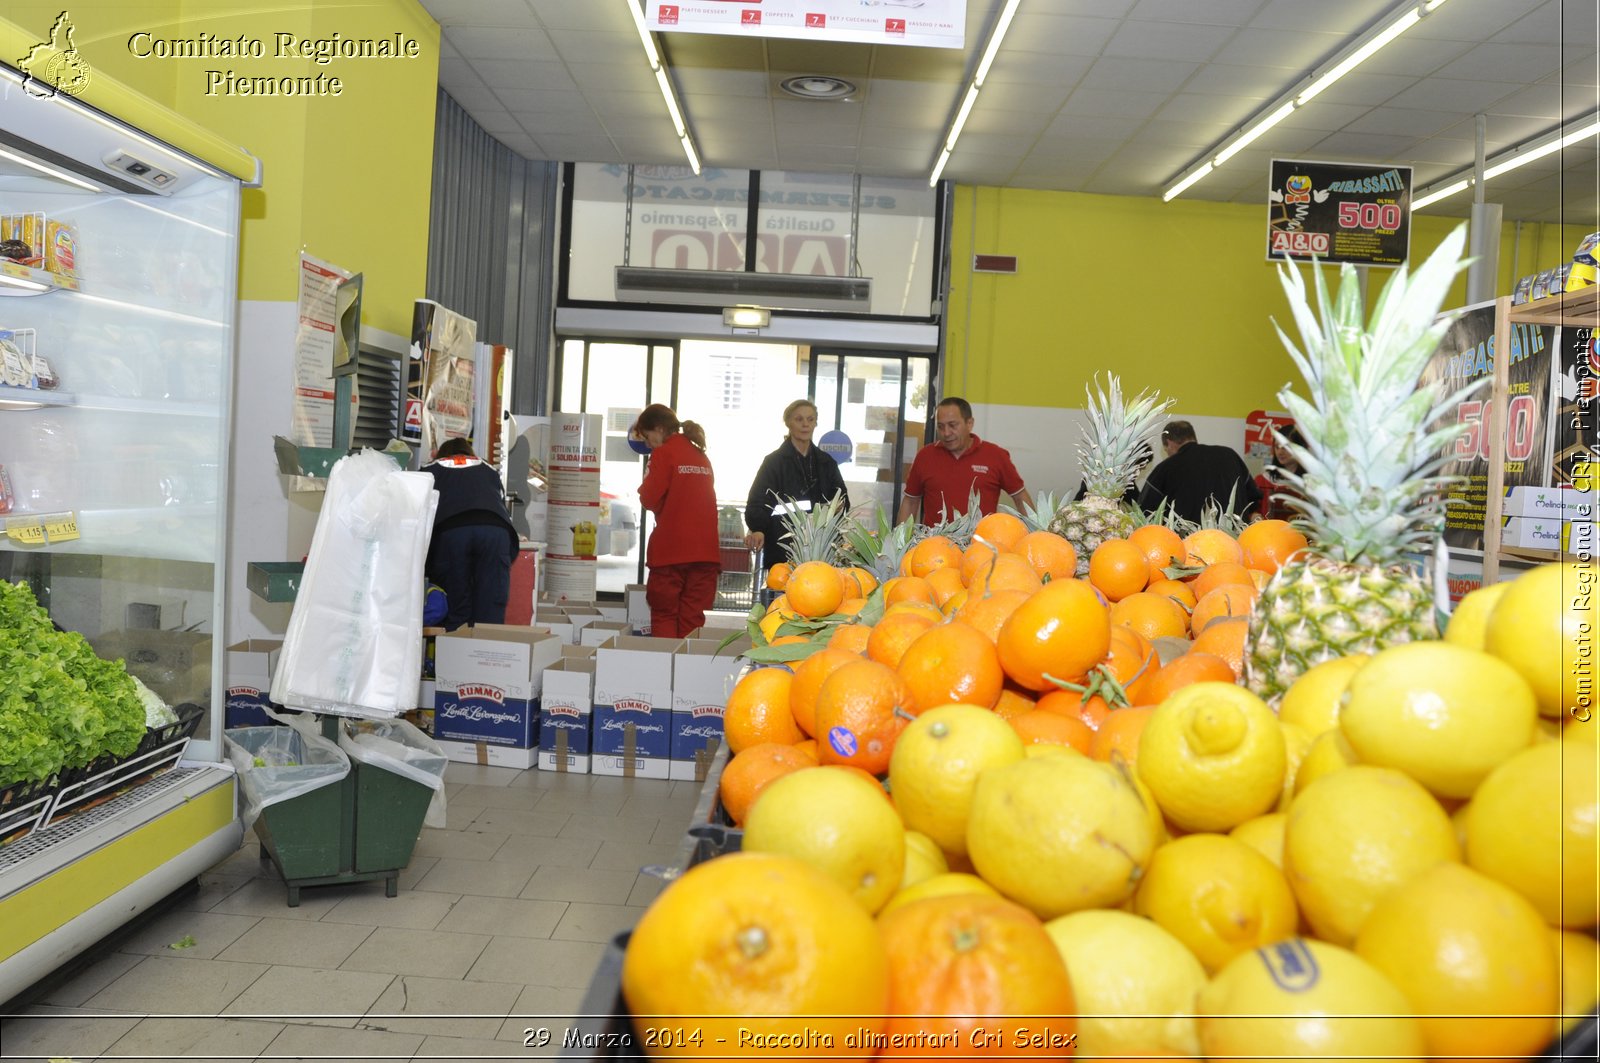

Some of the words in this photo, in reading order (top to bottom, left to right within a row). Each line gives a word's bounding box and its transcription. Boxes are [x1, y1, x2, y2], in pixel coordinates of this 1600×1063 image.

[812, 16, 819, 24] 7
[892, 21, 898, 29] 7
[1327, 168, 1405, 194] RIBASSATI!
[1338, 201, 1402, 231] 500
[1273, 231, 1330, 251] A&O
[1445, 321, 1545, 378] RIBASATI!
[1507, 383, 1529, 395] LTRE
[562, 424, 580, 432] SELEX
[1503, 461, 1525, 473] REZZI
[1535, 500, 1567, 509] Melinda
[26, 527, 41, 538] 1,15
[62, 522, 77, 533] 1,15
[231, 688, 258, 696] RUMMO
[459, 686, 503, 700] RUMMO
[440, 702, 468, 719] Lenta
[466, 705, 522, 724] Lavorazione
[551, 707, 578, 717] RUMMO
[615, 702, 650, 712] RUMMO
[600, 719, 624, 731] Lenta
[679, 725, 701, 737] Lenta
